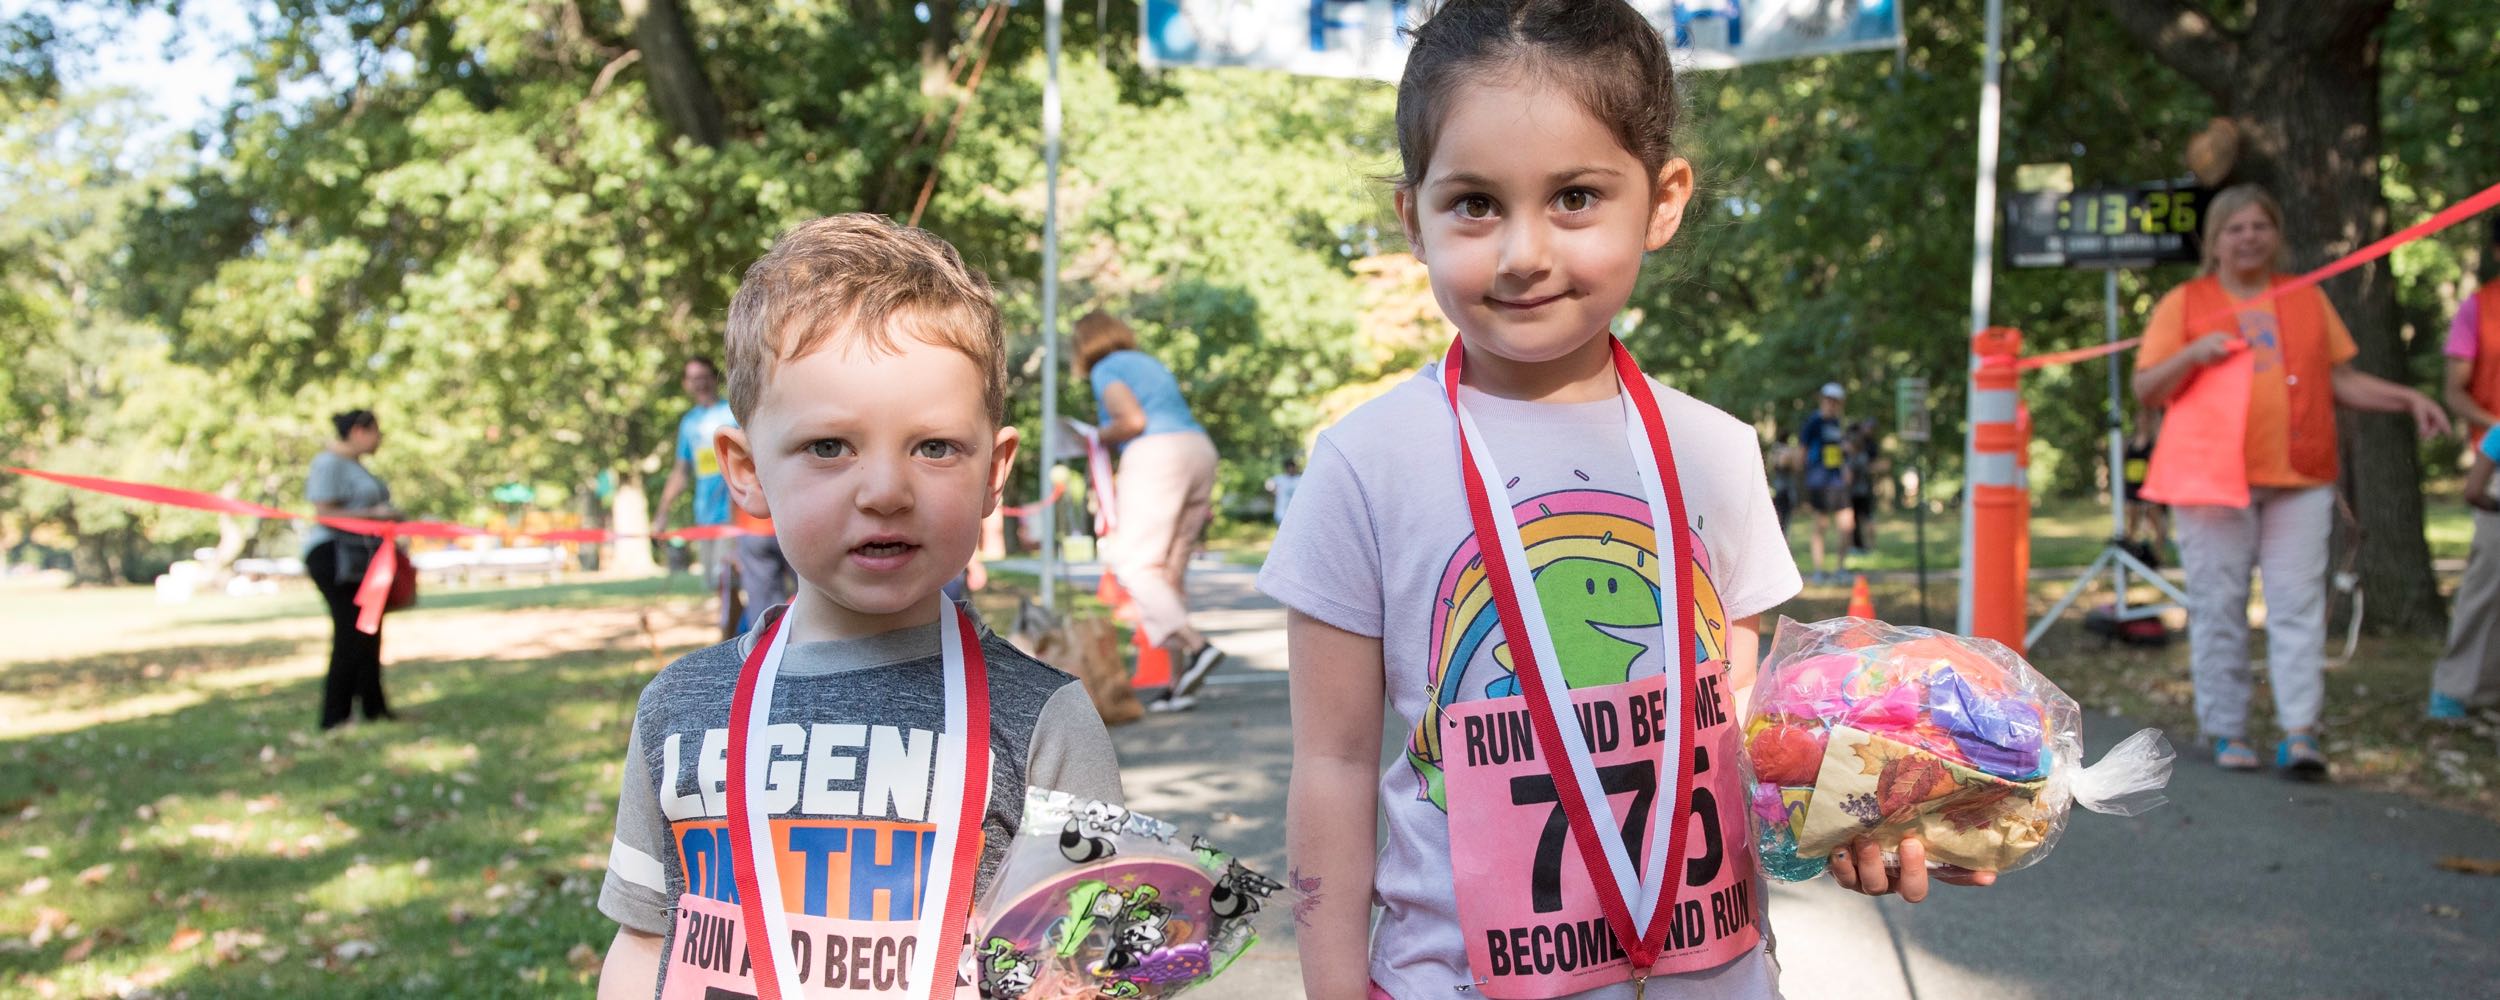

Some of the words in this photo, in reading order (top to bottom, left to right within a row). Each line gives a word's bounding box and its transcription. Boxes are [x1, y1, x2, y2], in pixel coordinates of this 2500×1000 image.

[1464, 709, 1535, 767] RUN
[1572, 700, 1619, 754] ND
[1629, 674, 1727, 747] BEME
[660, 723, 995, 824] LEGEN
[1510, 746, 1724, 914] 775
[682, 911, 735, 974] RUN
[825, 934, 971, 992] BECO
[1664, 899, 1705, 951] ND
[1711, 879, 1749, 939] RUN
